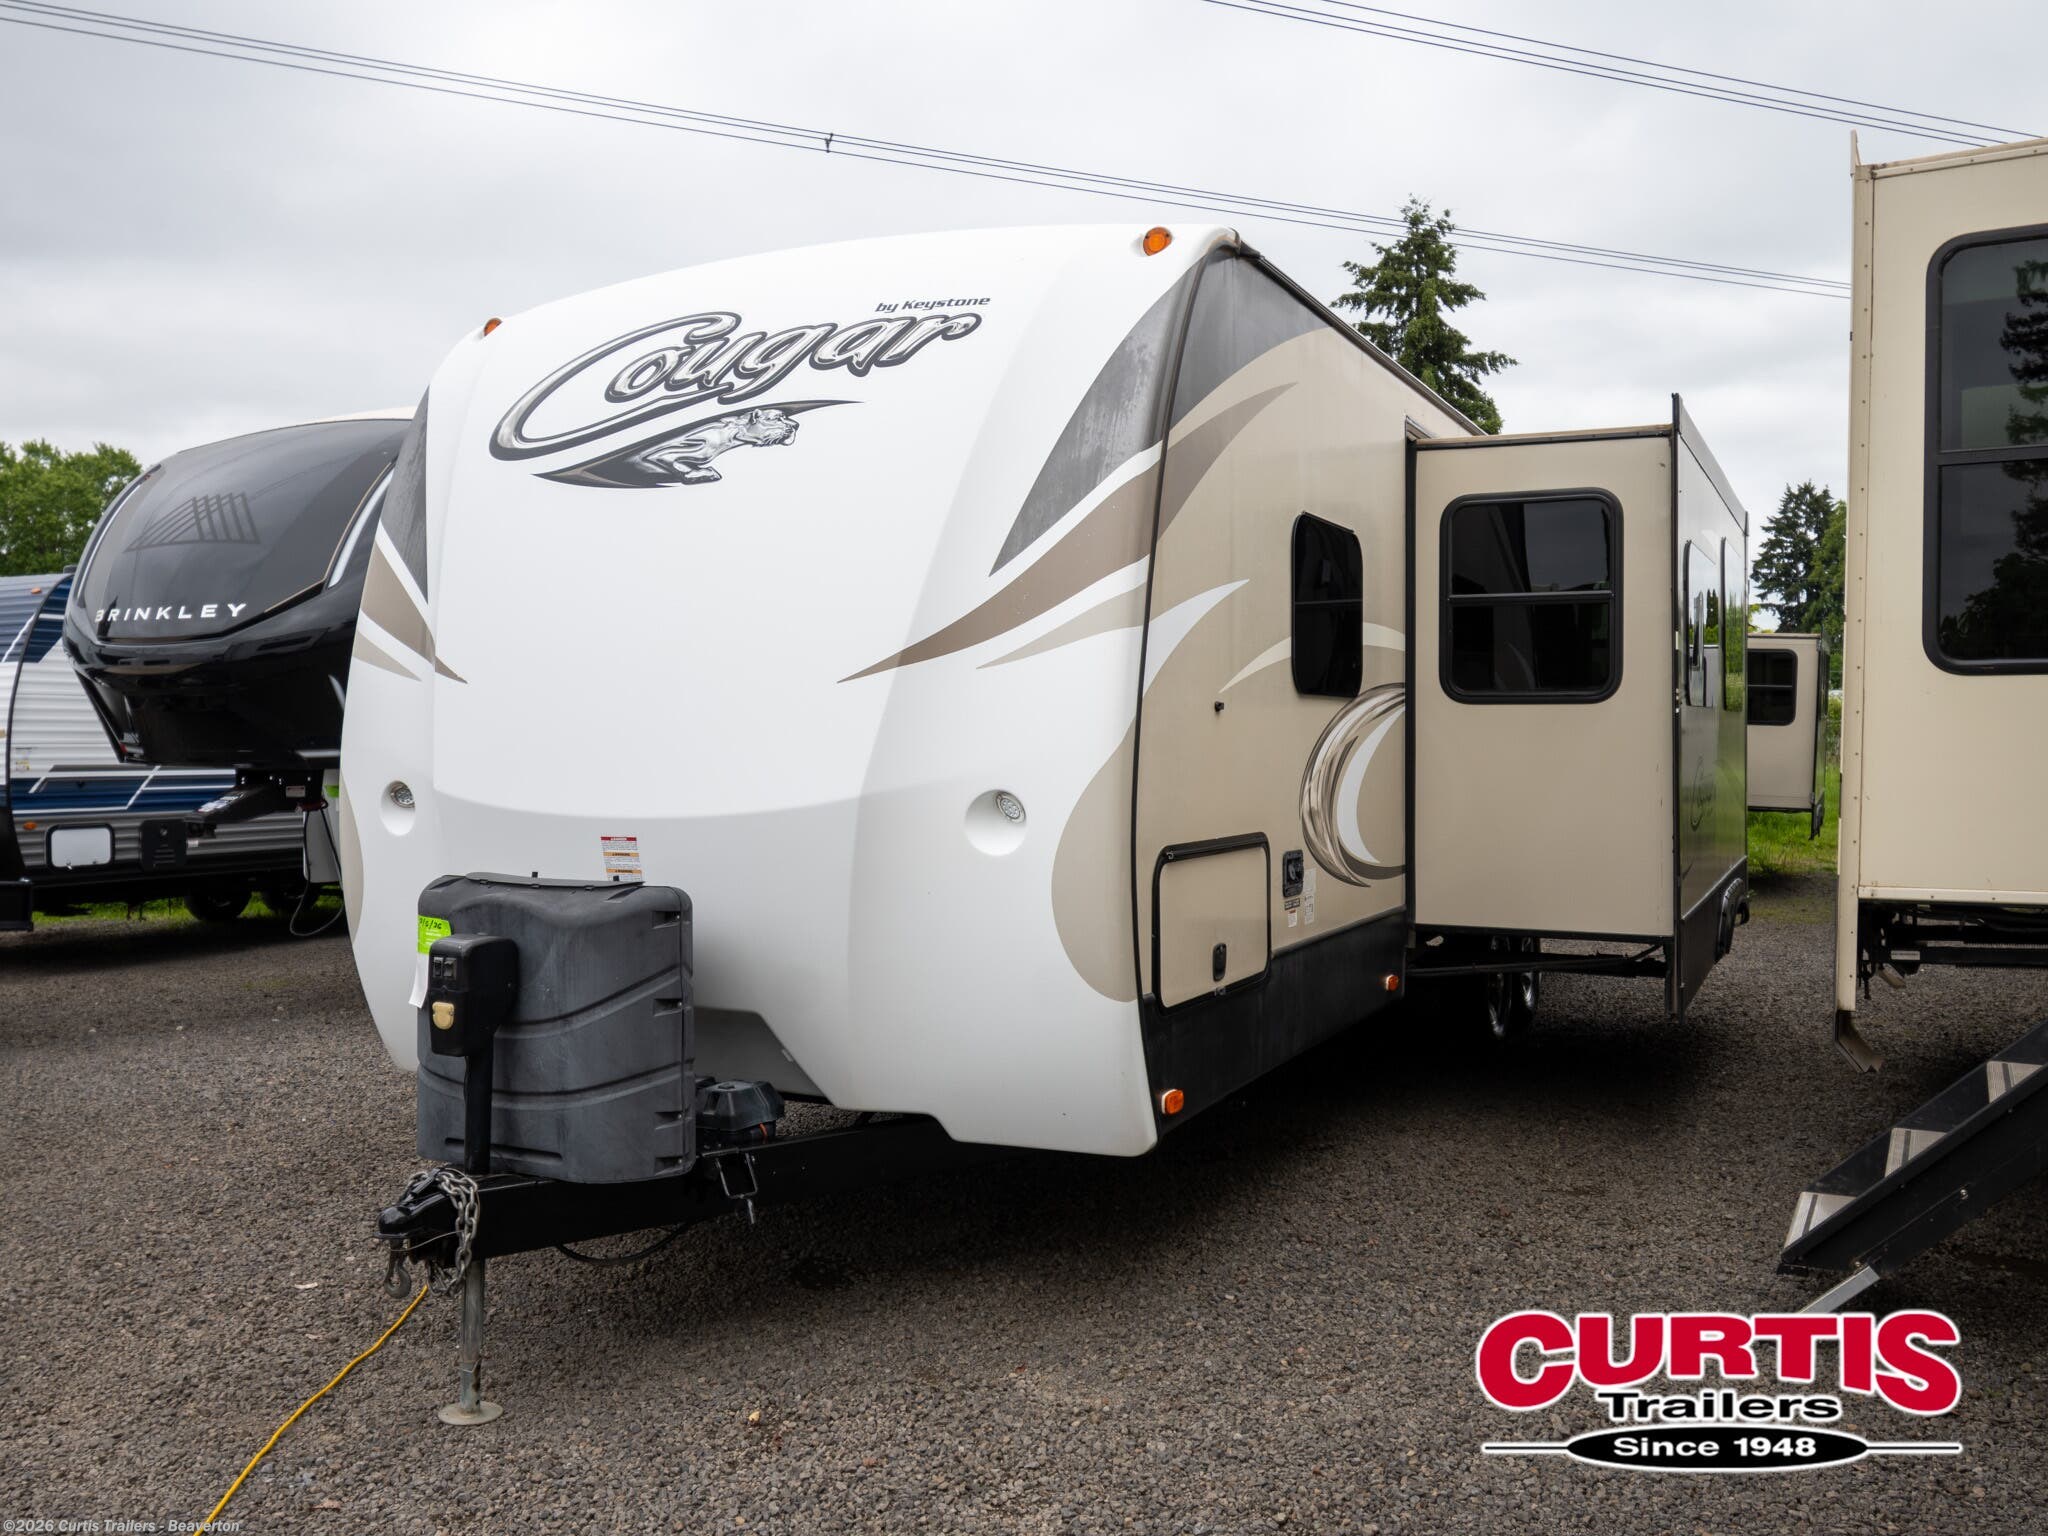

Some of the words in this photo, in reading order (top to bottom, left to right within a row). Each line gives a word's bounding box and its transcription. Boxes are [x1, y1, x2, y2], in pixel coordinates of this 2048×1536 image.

[875, 302, 899, 313] by
[902, 298, 990, 310] Keystone
[489, 311, 982, 461] Cougar
[95, 603, 246, 622] BRINKLEY
